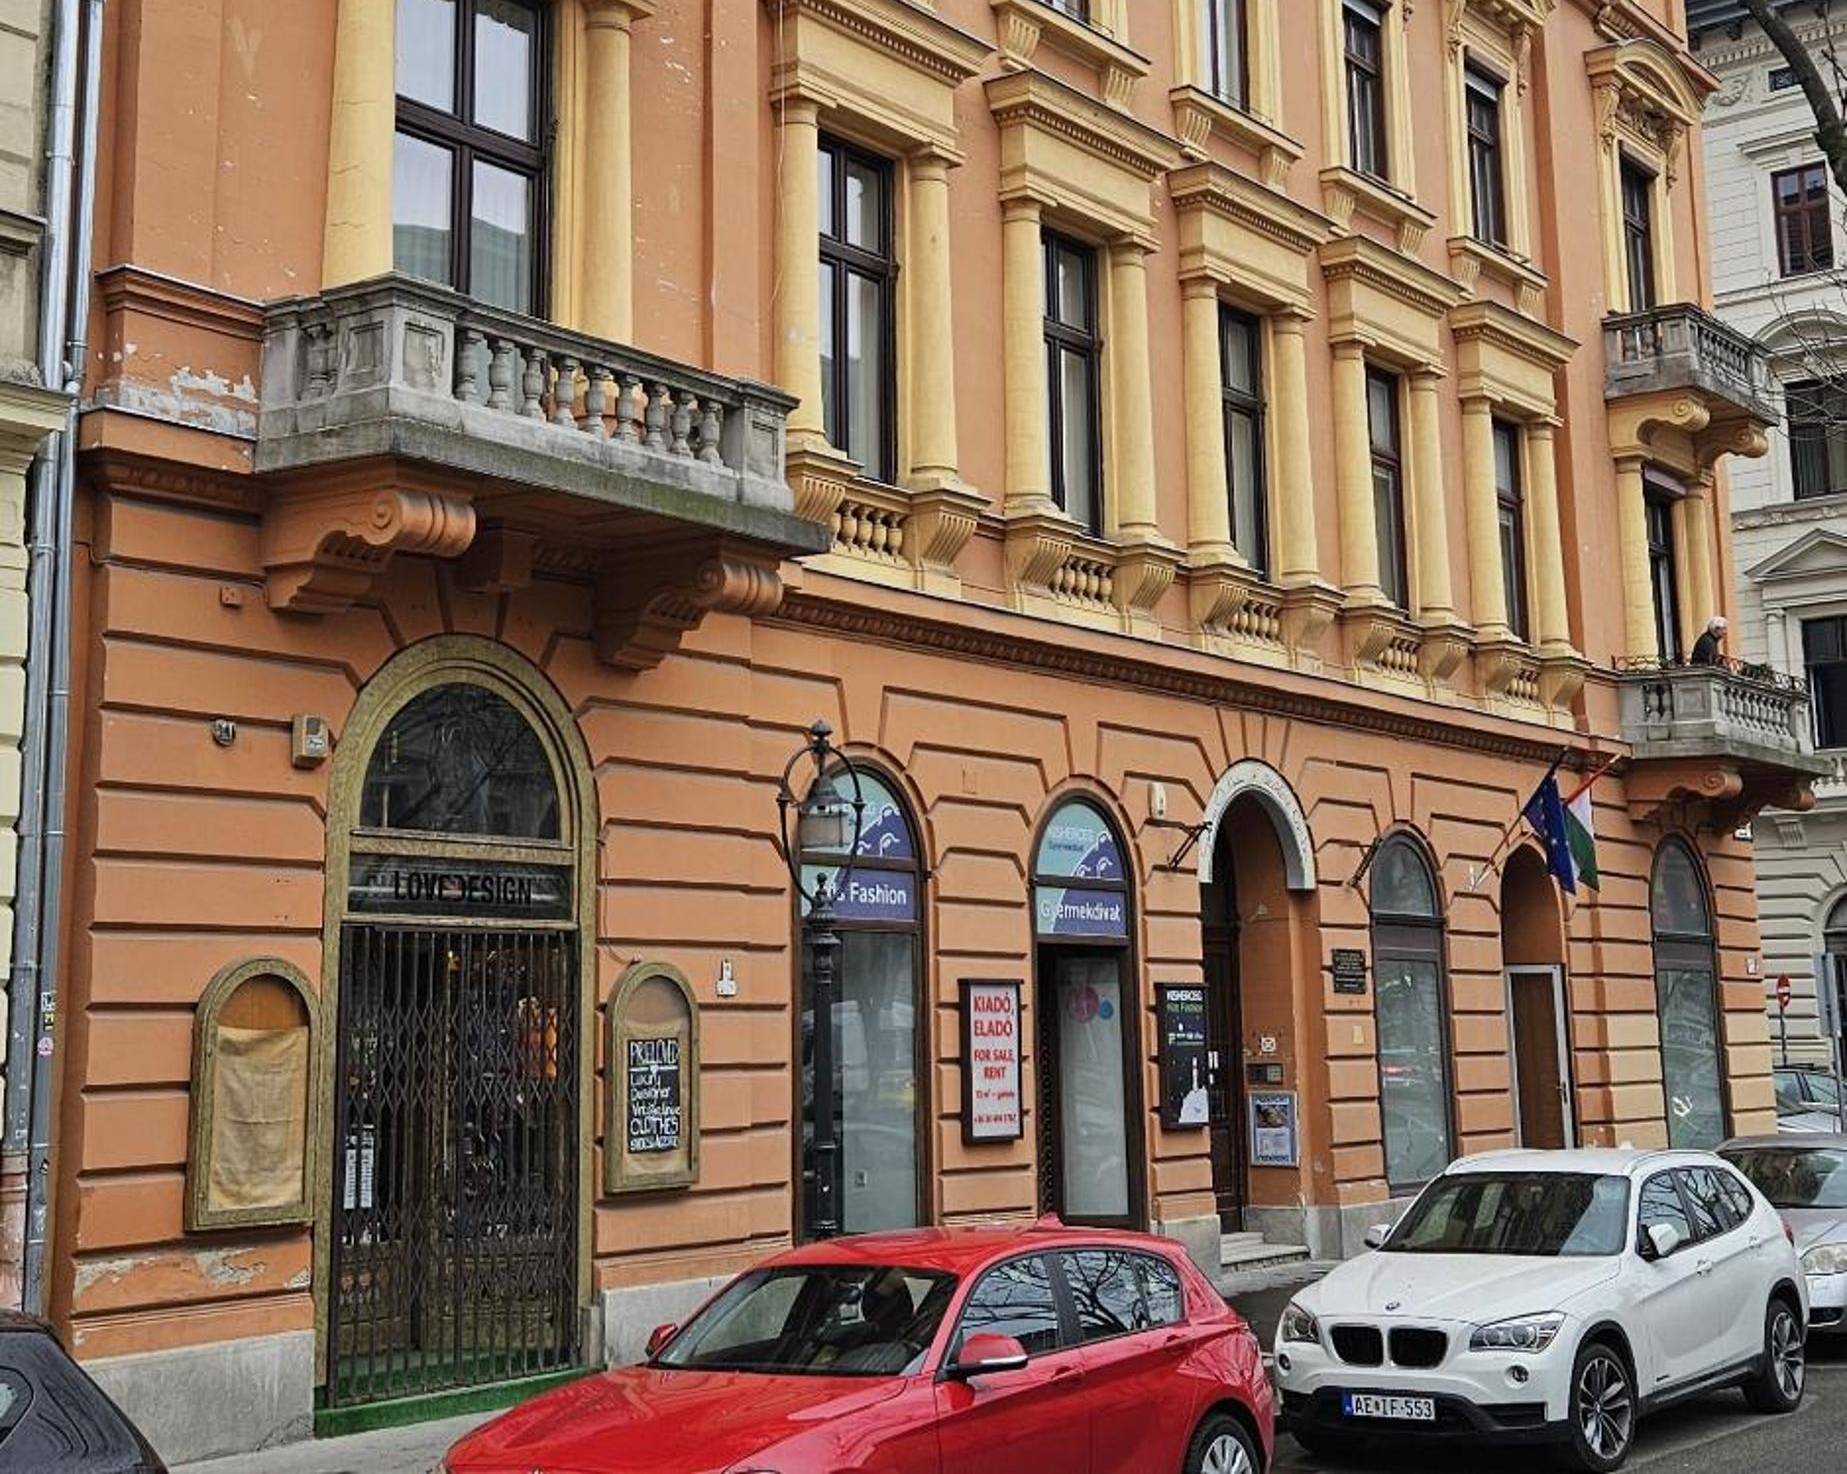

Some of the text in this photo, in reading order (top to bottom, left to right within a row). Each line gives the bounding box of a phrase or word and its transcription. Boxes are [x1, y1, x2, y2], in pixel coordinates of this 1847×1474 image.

[850, 882, 907, 905] Fashion
[974, 992, 1015, 1015] KIADÓ,
[974, 1016, 1013, 1037] ELADÓ
[974, 1049, 991, 1062] FOR
[984, 1066, 1007, 1080] RENT
[630, 1116, 679, 1136] CLOTHES
[1355, 1396, 1374, 1414] AE
